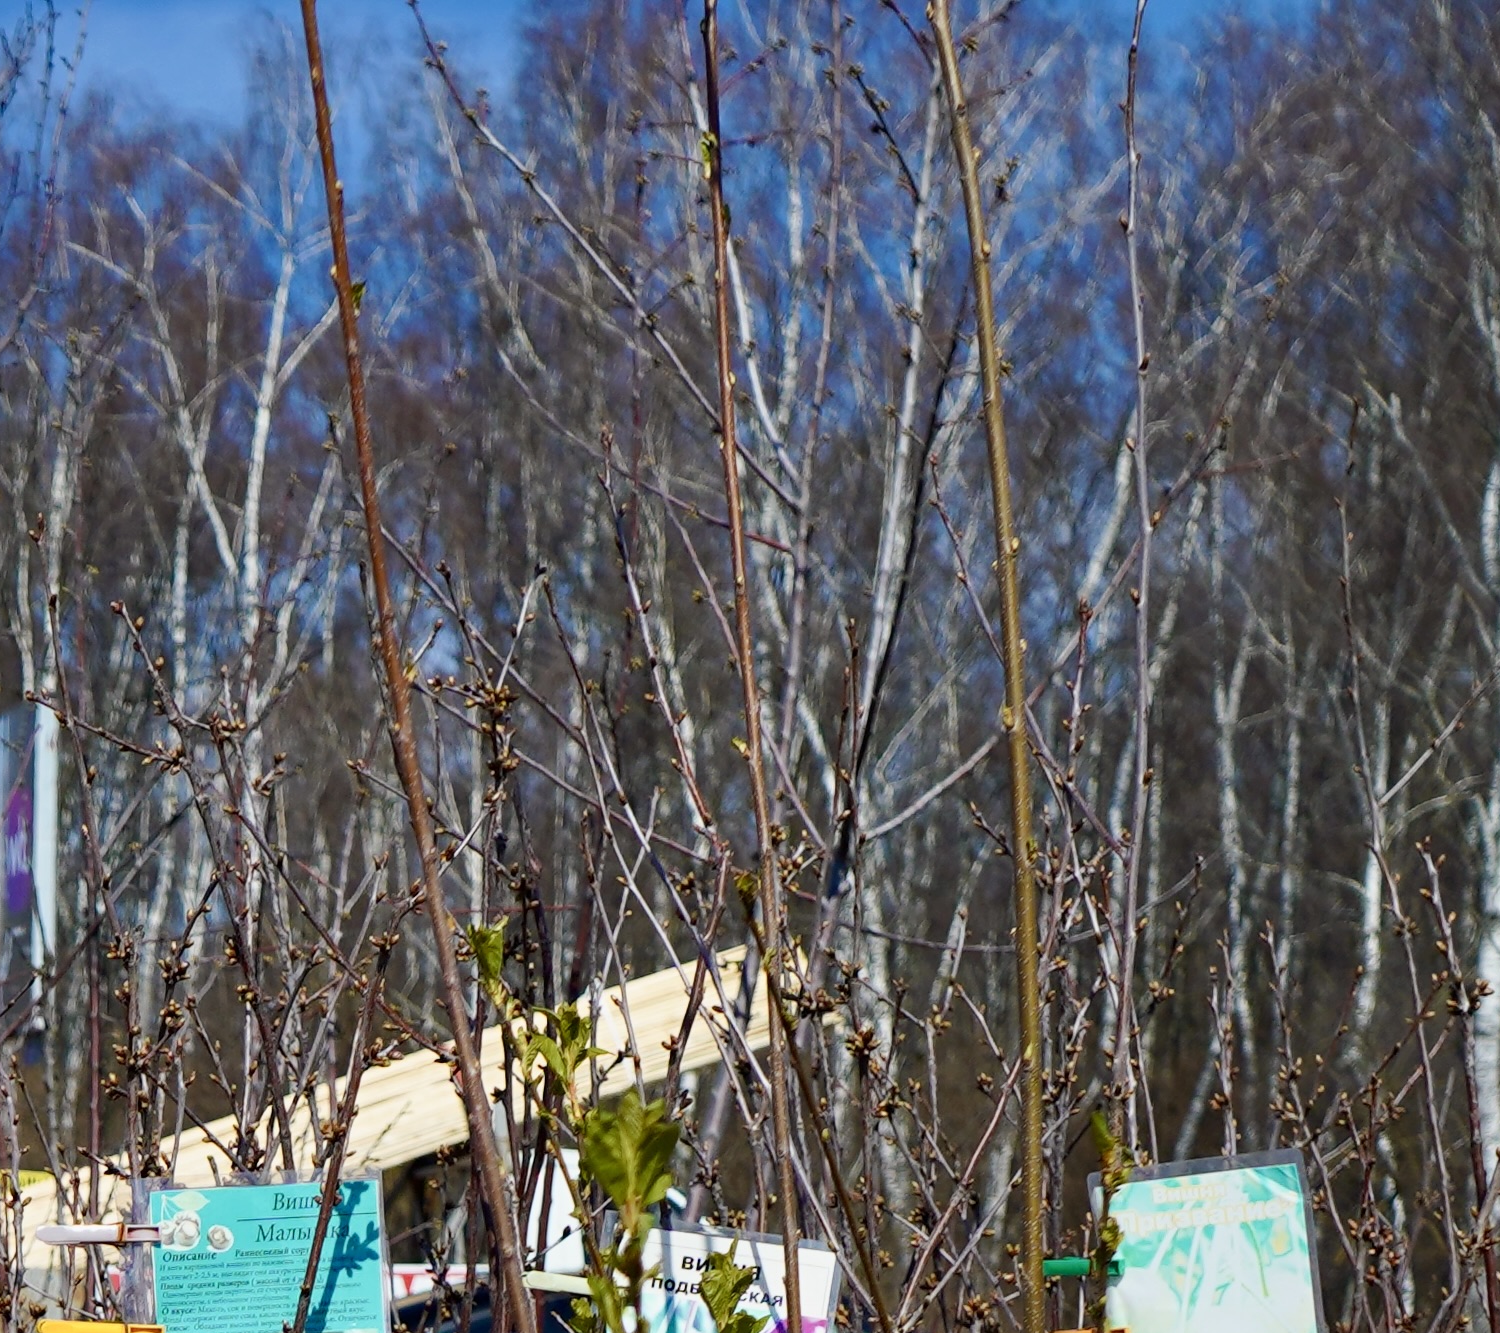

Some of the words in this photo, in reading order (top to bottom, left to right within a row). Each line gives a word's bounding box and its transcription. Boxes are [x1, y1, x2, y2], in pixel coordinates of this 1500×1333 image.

[273, 1192, 322, 1211] Виш
[255, 1222, 350, 1243] Малыка
[162, 1250, 217, 1262] Описание
[681, 1256, 761, 1281] ВИЯ
[651, 1277, 783, 1306] ПОДБСКАЯ
